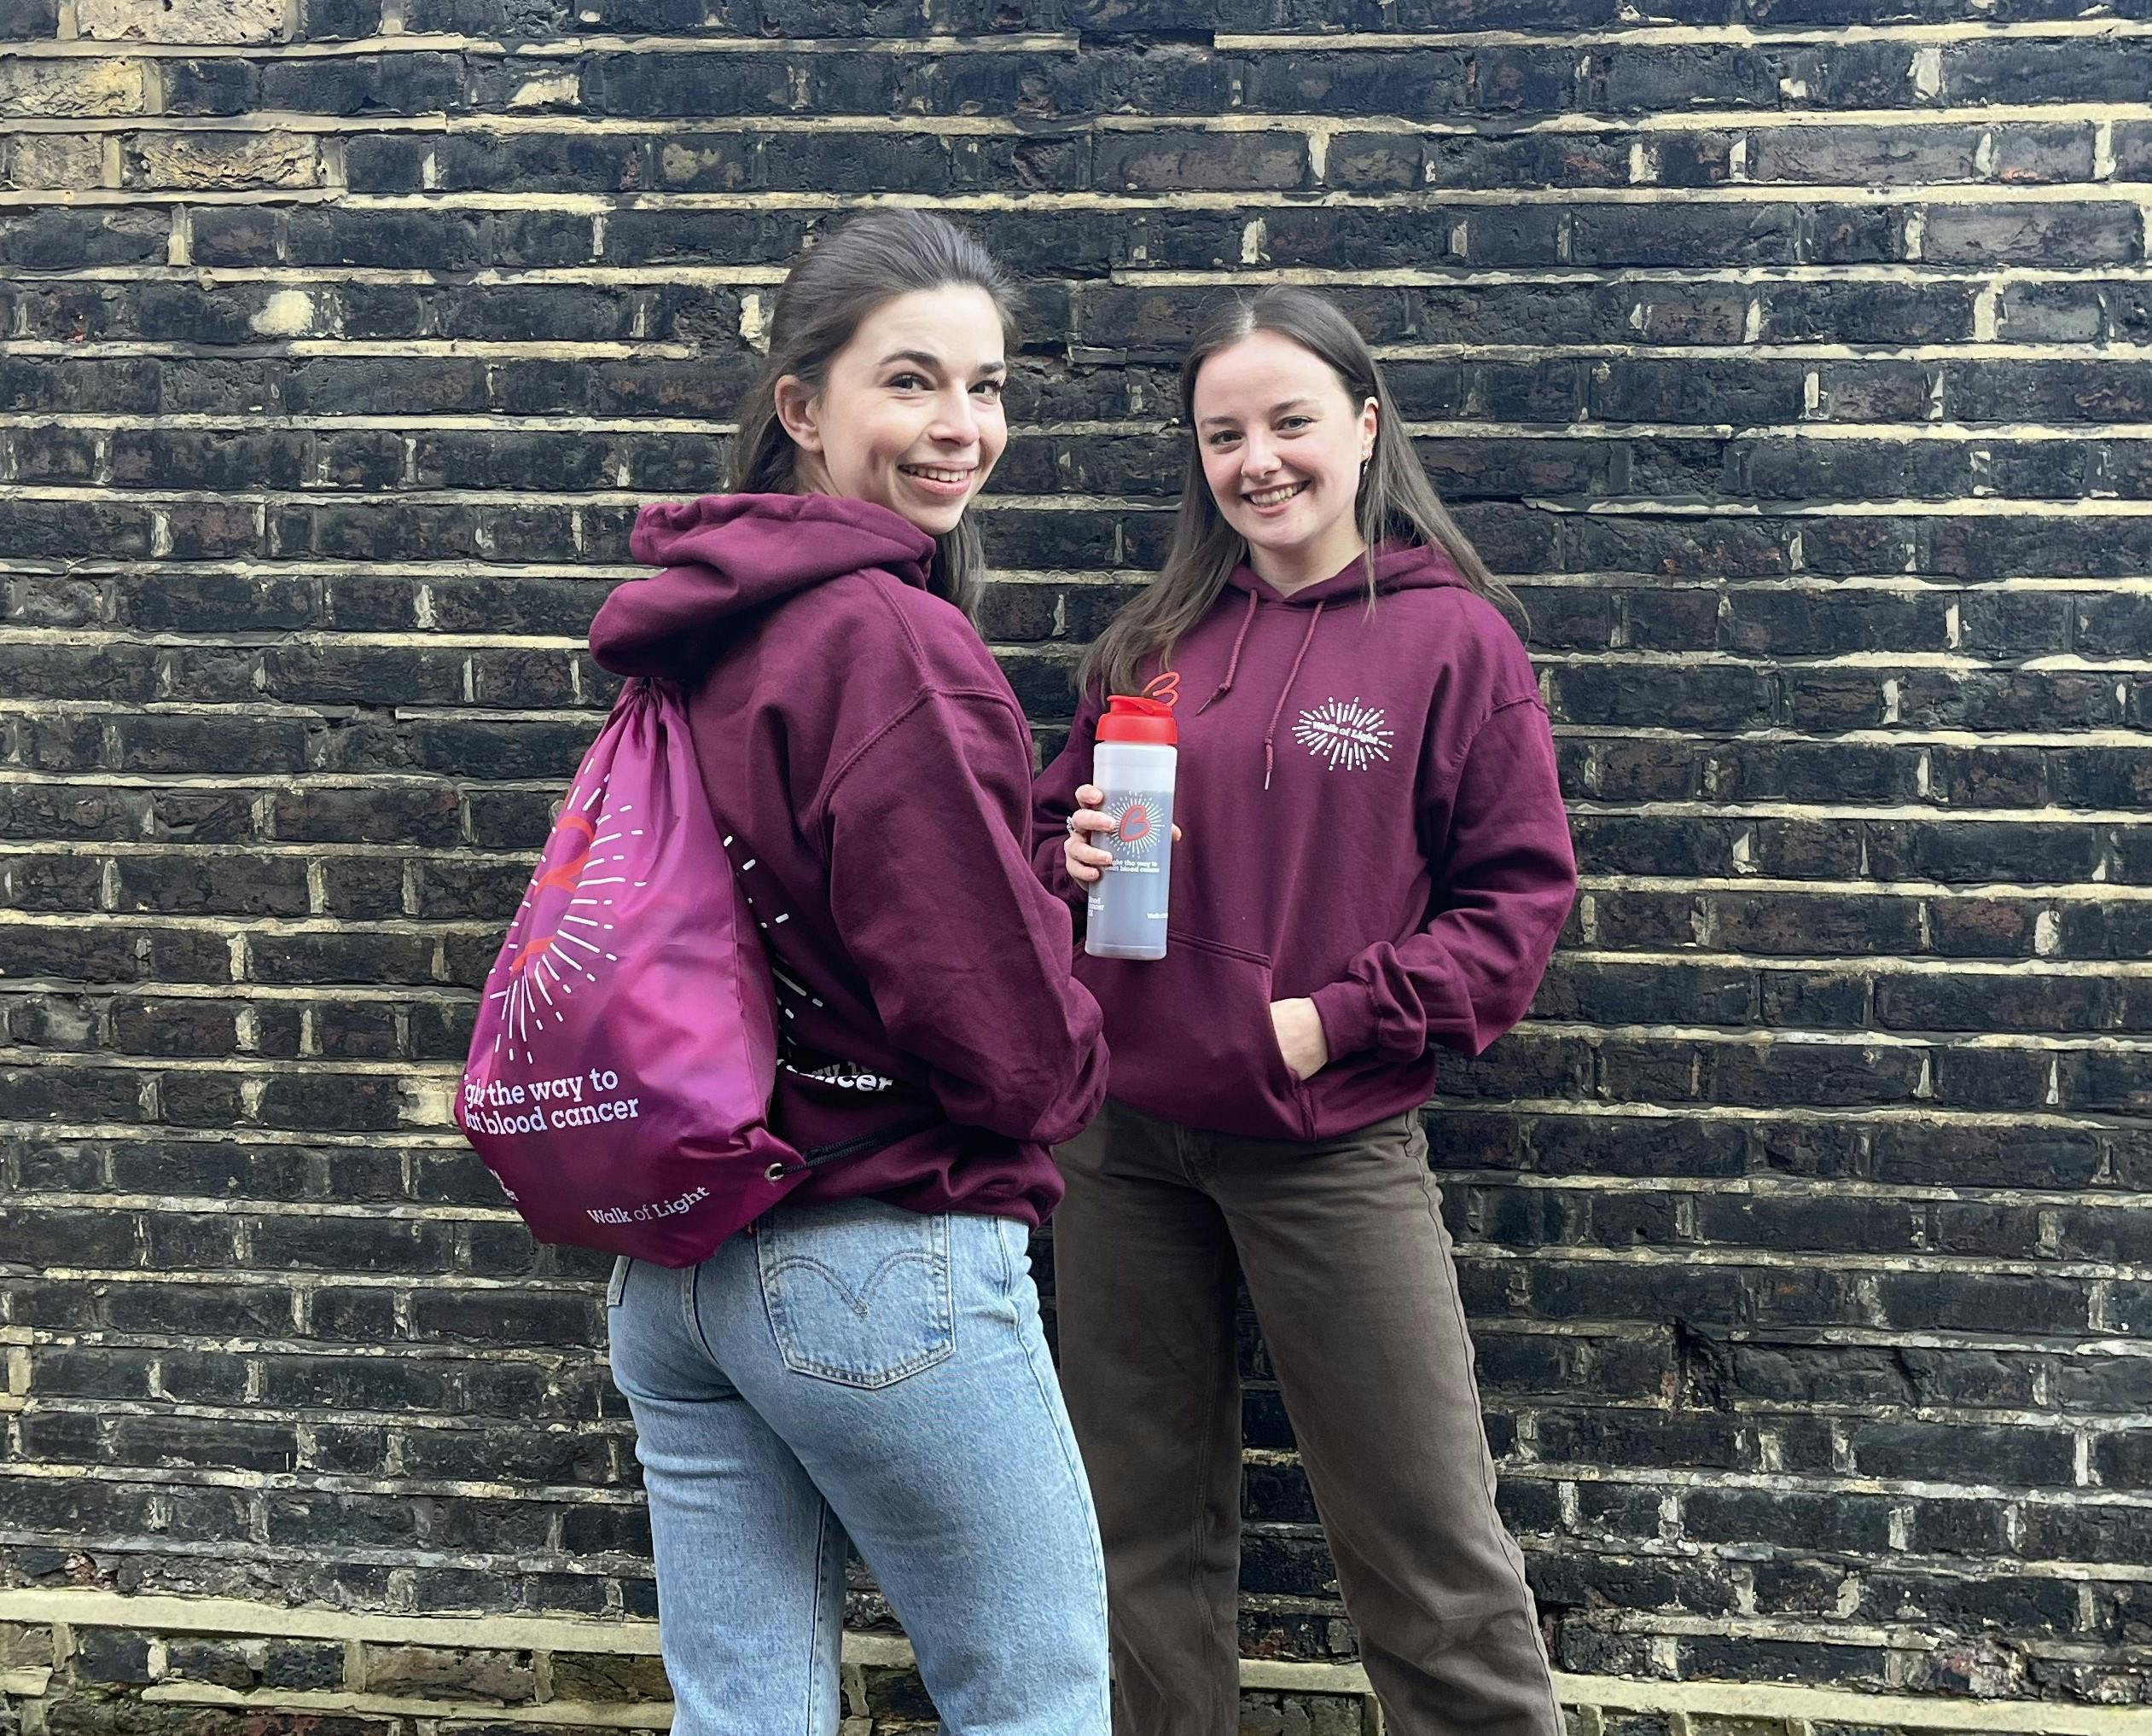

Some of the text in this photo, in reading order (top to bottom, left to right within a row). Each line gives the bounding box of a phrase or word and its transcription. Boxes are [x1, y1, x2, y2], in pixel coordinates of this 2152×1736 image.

[486, 1079, 526, 1106] the
[528, 1075, 584, 1103] way
[589, 1067, 619, 1092] to
[480, 1106, 549, 1135] blood
[550, 1098, 639, 1129] cancer
[586, 1186, 711, 1224] Walk of Light
